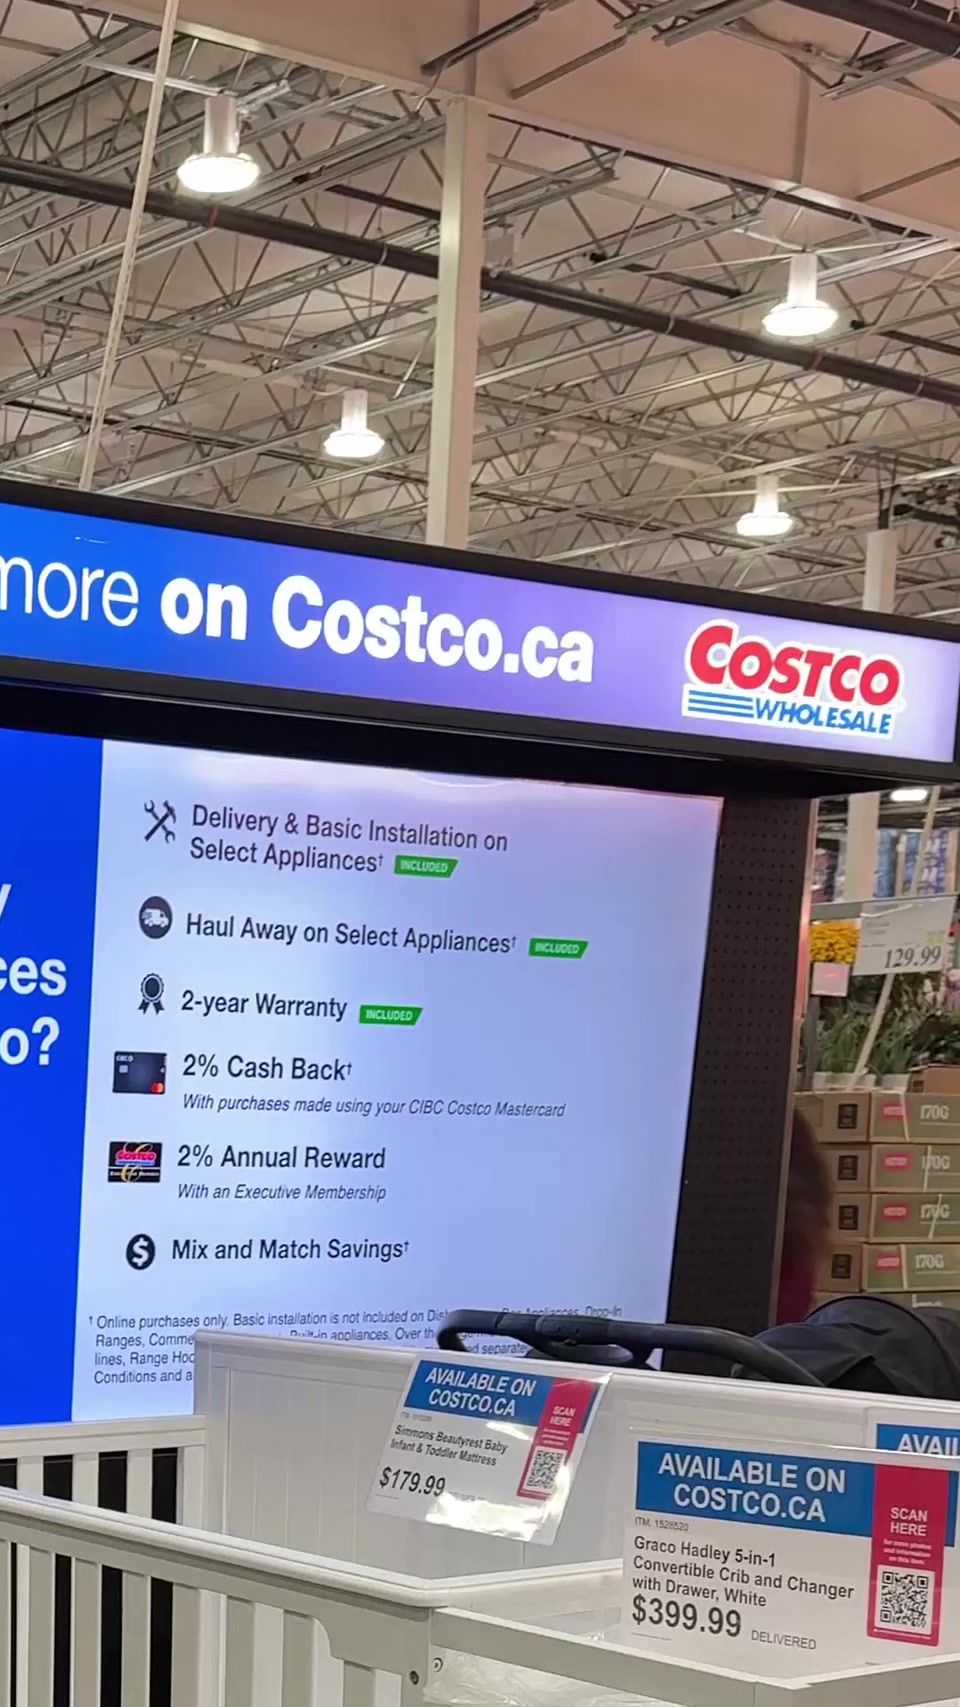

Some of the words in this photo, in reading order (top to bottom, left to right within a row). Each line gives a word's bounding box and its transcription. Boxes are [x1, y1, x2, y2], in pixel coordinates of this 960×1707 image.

[160, 576, 246, 641] on
[271, 573, 595, 683] Costco.ca
[687, 624, 902, 706] COSTCO
[752, 698, 892, 735] WHOLESALE
[191, 804, 279, 838] Delivery
[284, 811, 300, 835] &
[306, 814, 363, 840] Basic
[369, 819, 478, 850] Installation
[484, 833, 508, 852] on
[190, 836, 258, 864] Select
[400, 859, 449, 874] INCLUDED
[186, 912, 235, 938] Haul
[240, 916, 298, 946] Away
[304, 924, 329, 943] on
[335, 922, 398, 947] Select
[534, 941, 581, 956] INCLUDED
[884, 945, 942, 969] 129.99
[181, 989, 249, 1017] 2-year
[255, 992, 348, 1022] Warranty
[365, 1007, 413, 1022] INCLUDED
[183, 1053, 219, 1078] 2%
[227, 1055, 284, 1079] Cash
[183, 1093, 215, 1110] With
[217, 1095, 290, 1114] purchases
[293, 1096, 332, 1113] made
[335, 1099, 373, 1117] using
[374, 1101, 406, 1117] your
[409, 1098, 445, 1115] CIBC
[447, 1100, 492, 1116] Costco
[494, 1101, 567, 1118] Mastercard
[919, 1104, 951, 1120] 170G
[177, 1144, 213, 1168] 2%
[221, 1145, 297, 1169] Annual
[304, 1146, 386, 1169] Reward
[178, 1184, 210, 1200] With
[213, 1187, 230, 1200] an
[234, 1184, 302, 1201] Executive
[304, 1184, 387, 1203] Membership
[172, 1238, 208, 1260] Mix
[215, 1238, 253, 1259] and
[259, 1238, 321, 1260] Match
[915, 1254, 945, 1269] 170G
[96, 1315, 136, 1329] Online
[139, 1314, 200, 1331] purchases
[203, 1314, 229, 1329] only.
[233, 1313, 265, 1327] Basic
[268, 1312, 327, 1326] installation
[330, 1311, 339, 1324] is
[342, 1311, 360, 1325] not
[362, 1309, 409, 1323] included
[410, 1311, 424, 1323] on
[95, 1334, 145, 1350] Ranges,
[149, 1333, 194, 1346] Comme
[395, 1326, 421, 1340] Over
[95, 1352, 126, 1367] lines,
[130, 1351, 169, 1367] Range
[93, 1370, 157, 1384] Conditions
[160, 1369, 183, 1382] and
[425, 1366, 507, 1394] AVAILABLE
[510, 1378, 536, 1397] ON
[428, 1388, 517, 1417] COSTCO.CA
[552, 1405, 576, 1417] SCAN
[549, 1415, 573, 1427] HERE
[395, 1424, 435, 1441] Simmons
[436, 1431, 483, 1449] Beautyrest
[484, 1438, 509, 1455] Baby
[897, 1433, 959, 1455] AVAIL
[390, 1438, 416, 1452] Infant
[416, 1443, 423, 1454] &
[425, 1444, 458, 1459] Toddler
[459, 1450, 498, 1467] Mattress
[379, 1465, 447, 1498] $179.99
[657, 1451, 798, 1489] AVAILABLE
[806, 1466, 847, 1494] ON
[673, 1482, 827, 1523] COSTCO.CA
[890, 1506, 929, 1523] SCAN
[890, 1521, 928, 1537] HERE
[634, 1535, 677, 1555] Graco
[681, 1541, 730, 1565] Hadley
[734, 1548, 776, 1568] 5-in-1
[633, 1555, 716, 1581] Convertible
[719, 1566, 750, 1585] Crib
[754, 1571, 783, 1589] and
[787, 1576, 855, 1600] Changer
[632, 1575, 662, 1593] with
[665, 1579, 720, 1602] Drawer,
[724, 1588, 768, 1608] White
[632, 1593, 742, 1638] $399.99
[751, 1629, 817, 1651] DELIVERED
